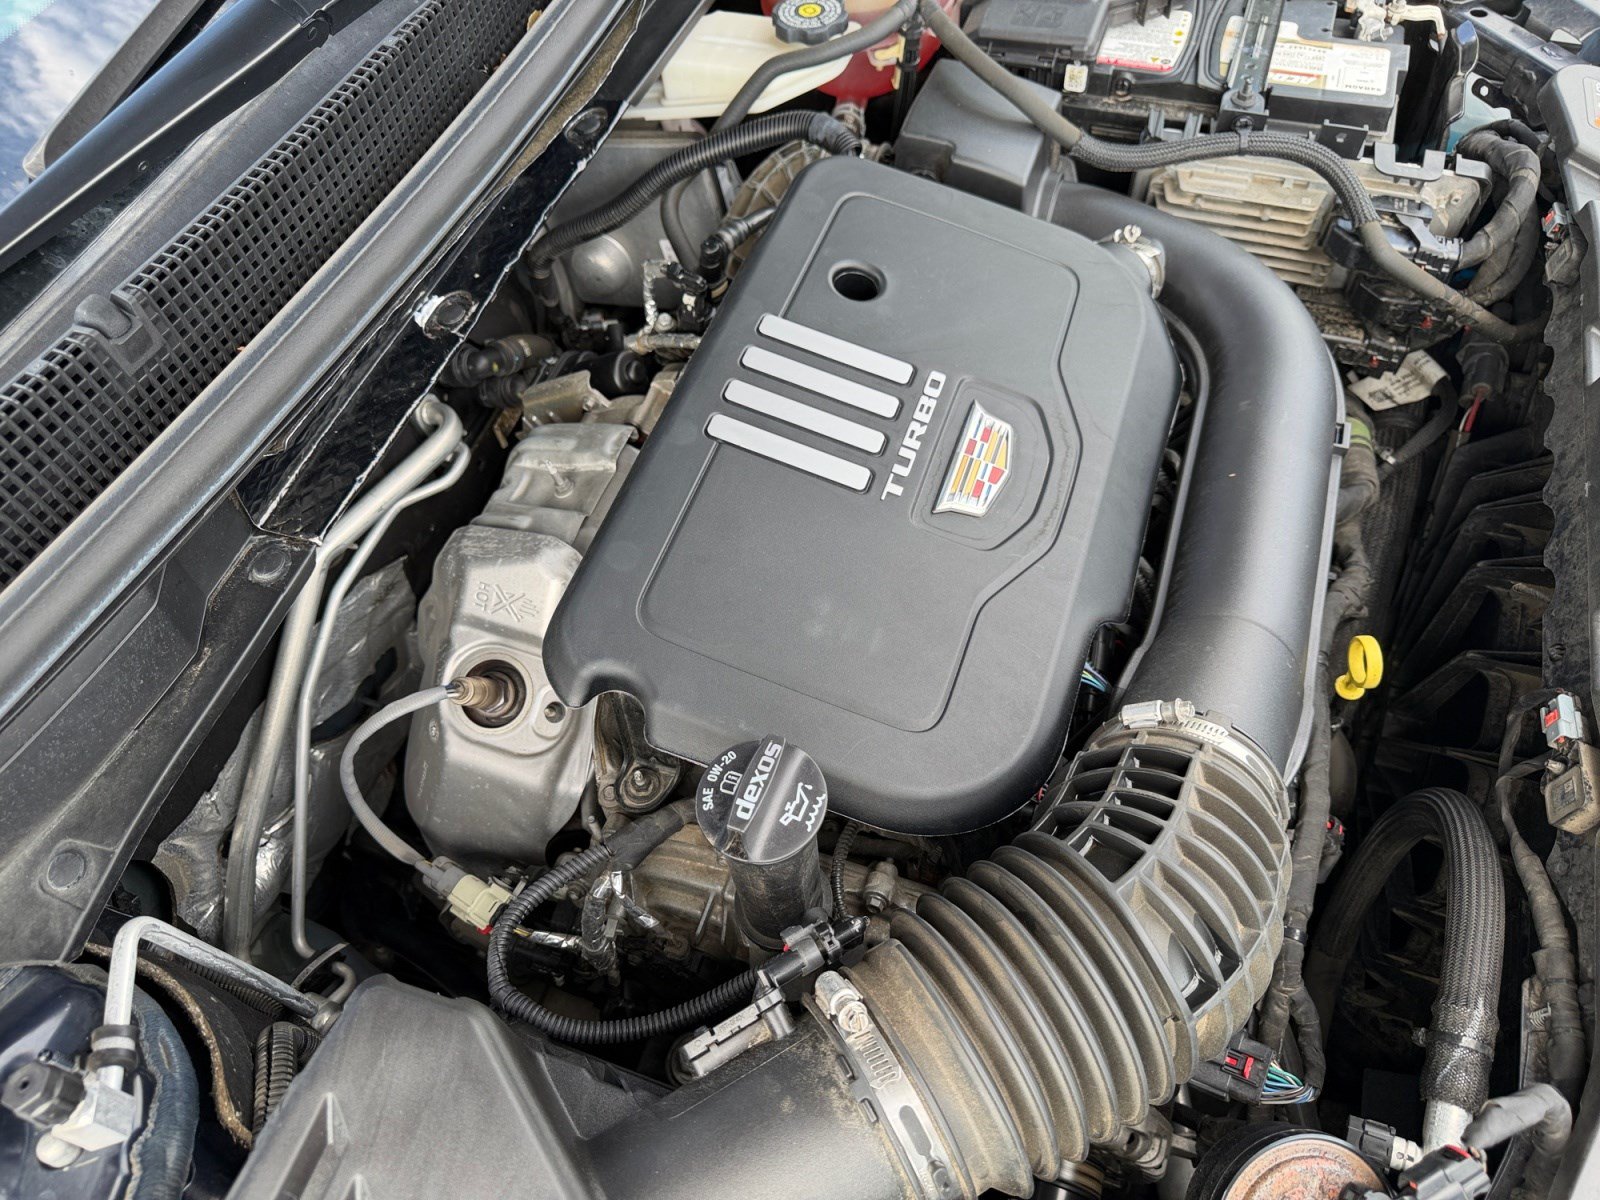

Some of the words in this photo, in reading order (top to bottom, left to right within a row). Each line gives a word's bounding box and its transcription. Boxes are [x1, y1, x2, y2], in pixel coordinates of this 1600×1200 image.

[880, 370, 947, 501] TURBO
[475, 581, 491, 612] HOT
[707, 751, 737, 782] 0W-20
[735, 740, 782, 820] dexos
[702, 787, 714, 811] SAE
